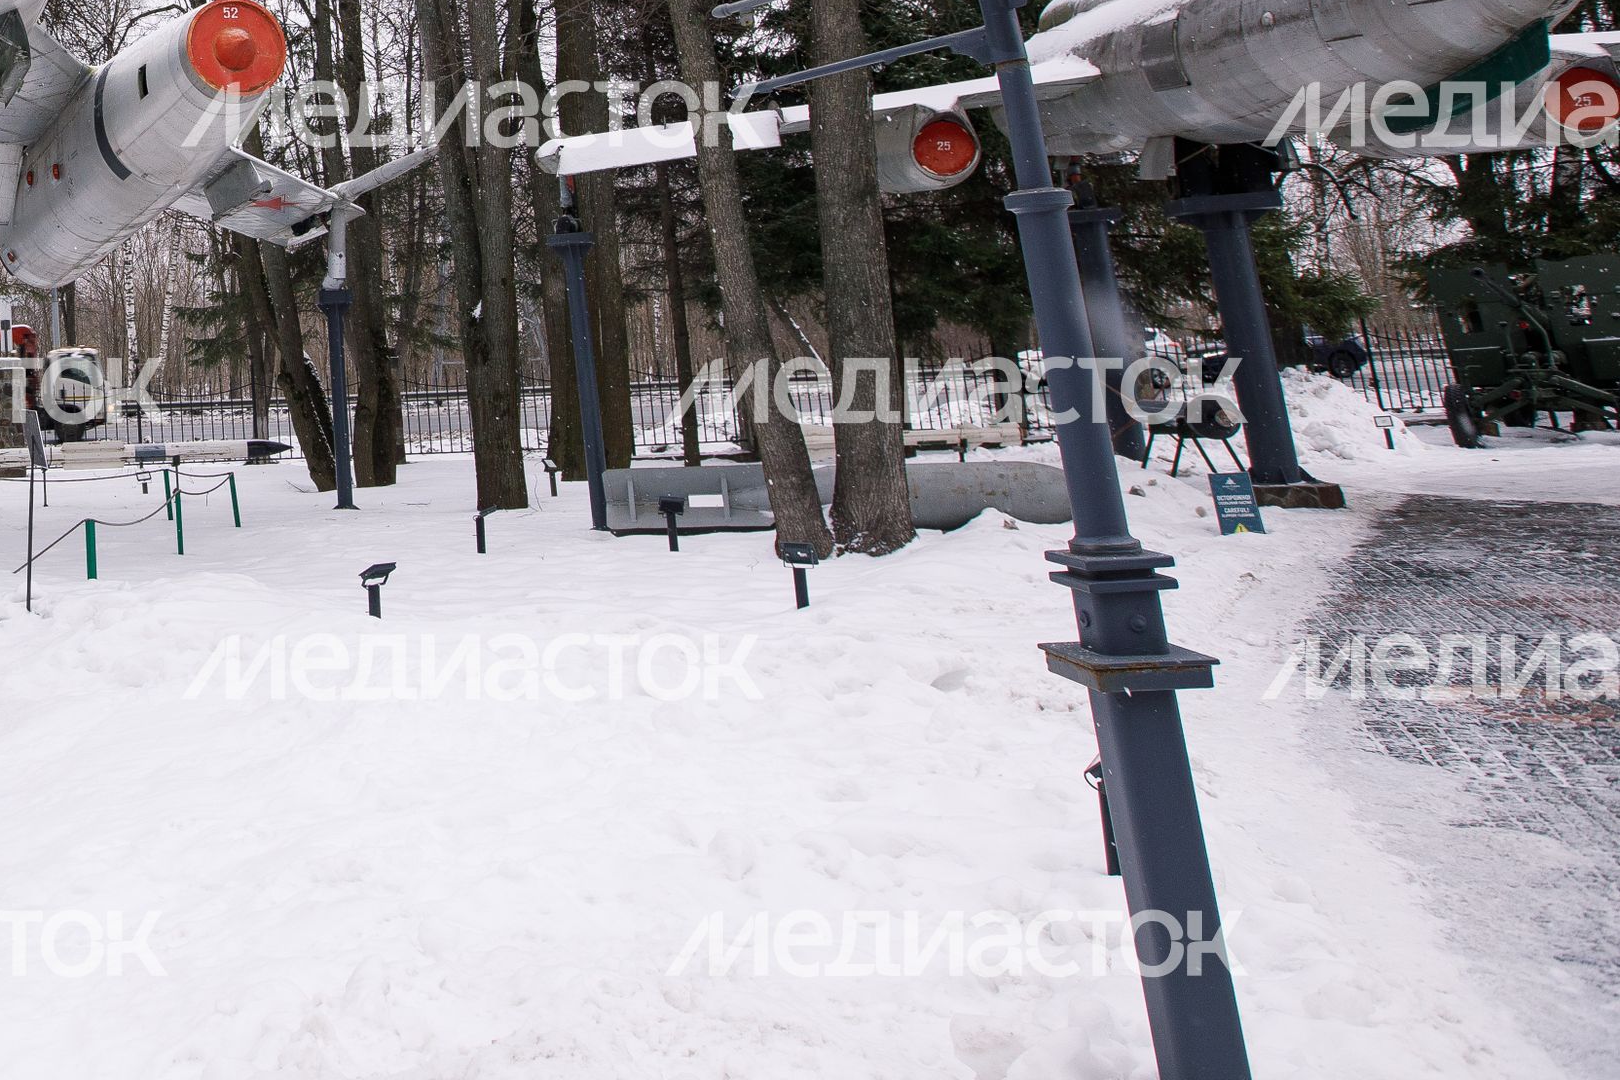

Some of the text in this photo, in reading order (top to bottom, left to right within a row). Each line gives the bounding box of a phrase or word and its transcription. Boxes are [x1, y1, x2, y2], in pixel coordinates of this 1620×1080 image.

[223, 7, 238, 18] 52
[1574, 96, 1591, 107] 25
[936, 141, 951, 151] 25
